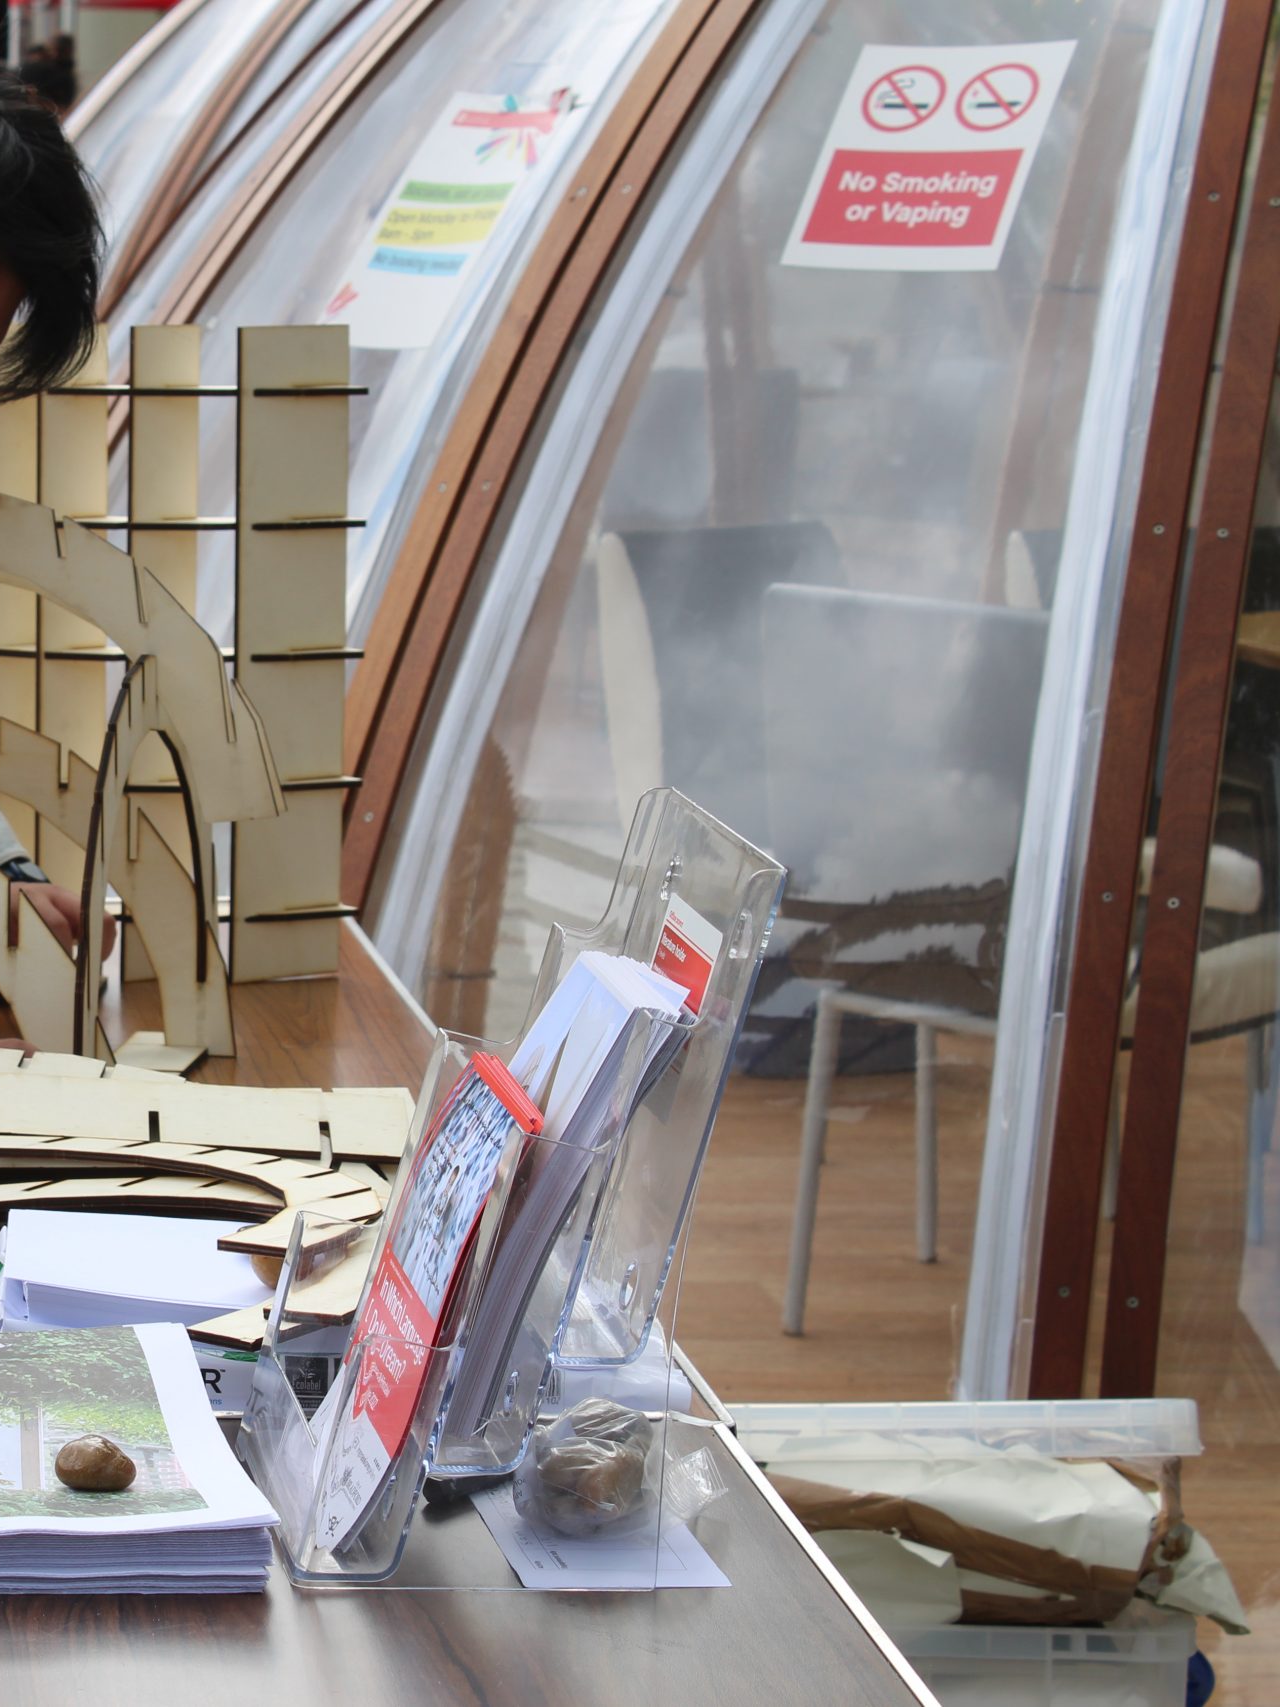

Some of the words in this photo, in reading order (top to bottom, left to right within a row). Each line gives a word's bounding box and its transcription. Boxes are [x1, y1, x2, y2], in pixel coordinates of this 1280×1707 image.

[838, 170, 877, 192] No
[881, 170, 998, 197] Smoking
[844, 202, 876, 222] or
[881, 201, 971, 227] Vaping
[385, 1279, 403, 1325] Which
[398, 1303, 426, 1366] Language
